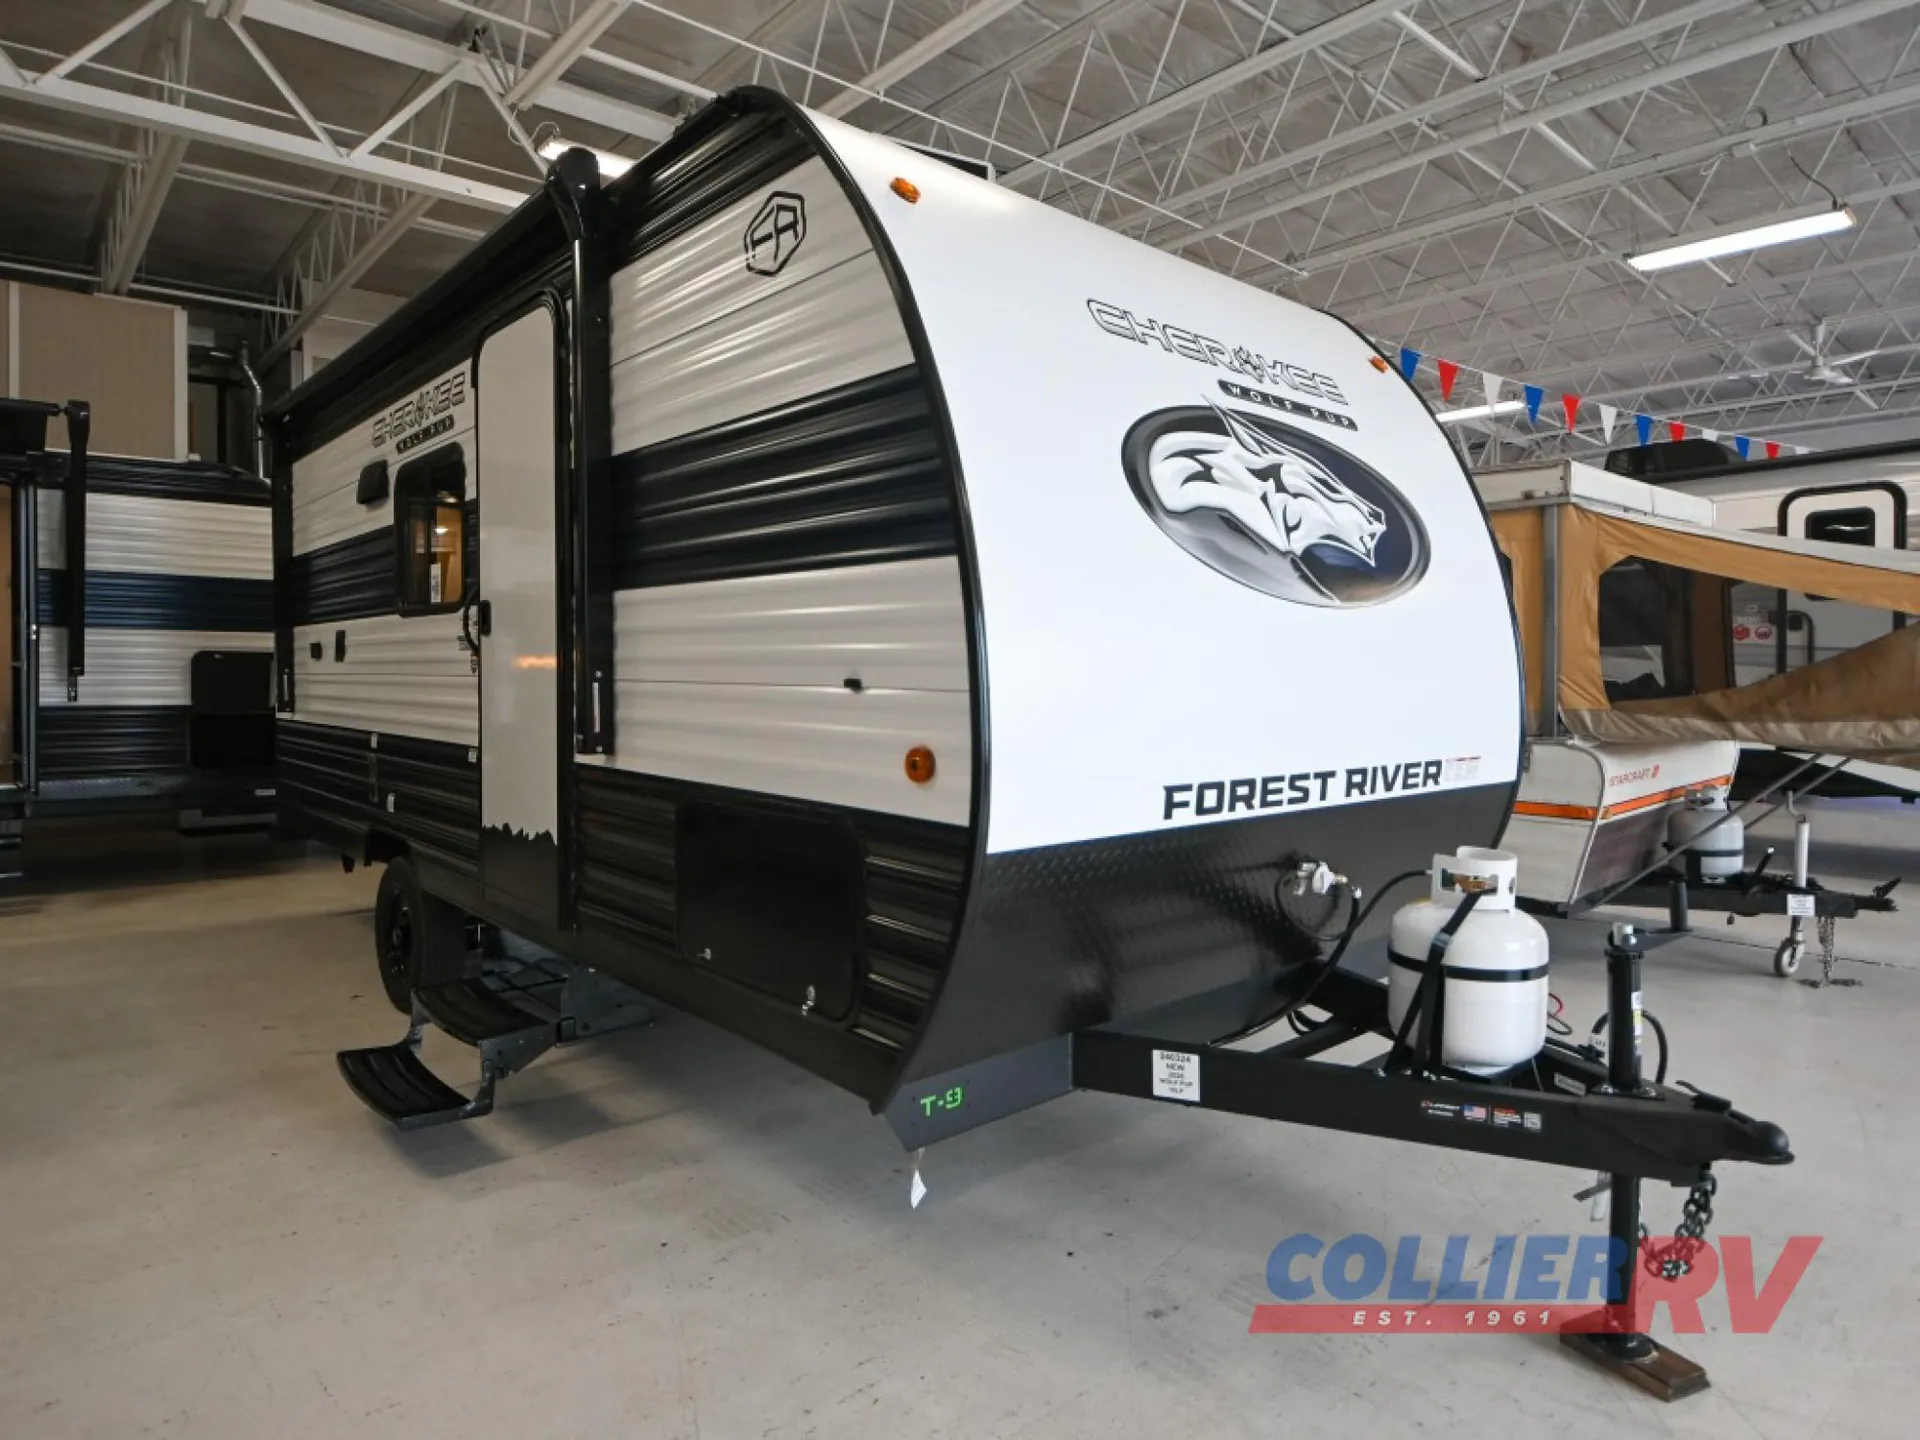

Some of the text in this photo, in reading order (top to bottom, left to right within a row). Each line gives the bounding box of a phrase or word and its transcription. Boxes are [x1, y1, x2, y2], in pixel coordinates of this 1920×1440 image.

[1227, 384, 1350, 427] WOLF PUP
[1162, 770, 1336, 820] FOREST
[1344, 759, 1443, 798] RIVER
[1165, 1062, 1186, 1072] NEW
[919, 1086, 963, 1117] T-9
